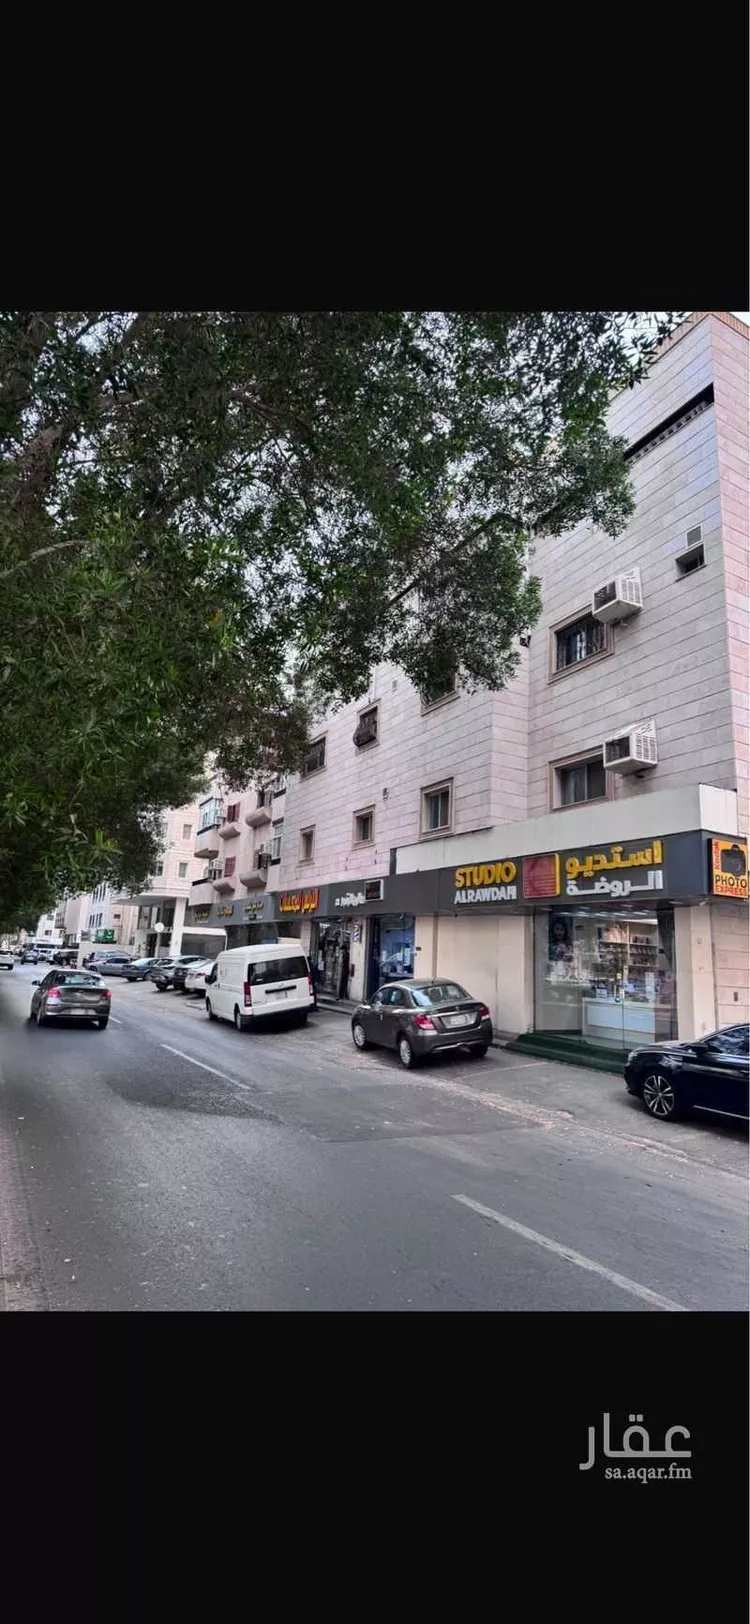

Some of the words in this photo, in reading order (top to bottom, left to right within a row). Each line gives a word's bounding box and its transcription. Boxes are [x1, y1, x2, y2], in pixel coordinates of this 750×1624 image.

[565, 840, 663, 880] استديو
[455, 861, 517, 888] STUDIO
[715, 874, 748, 889] PHOTO
[453, 886, 518, 905] ALRAWDAH
[715, 885, 748, 897] EXPRESS
